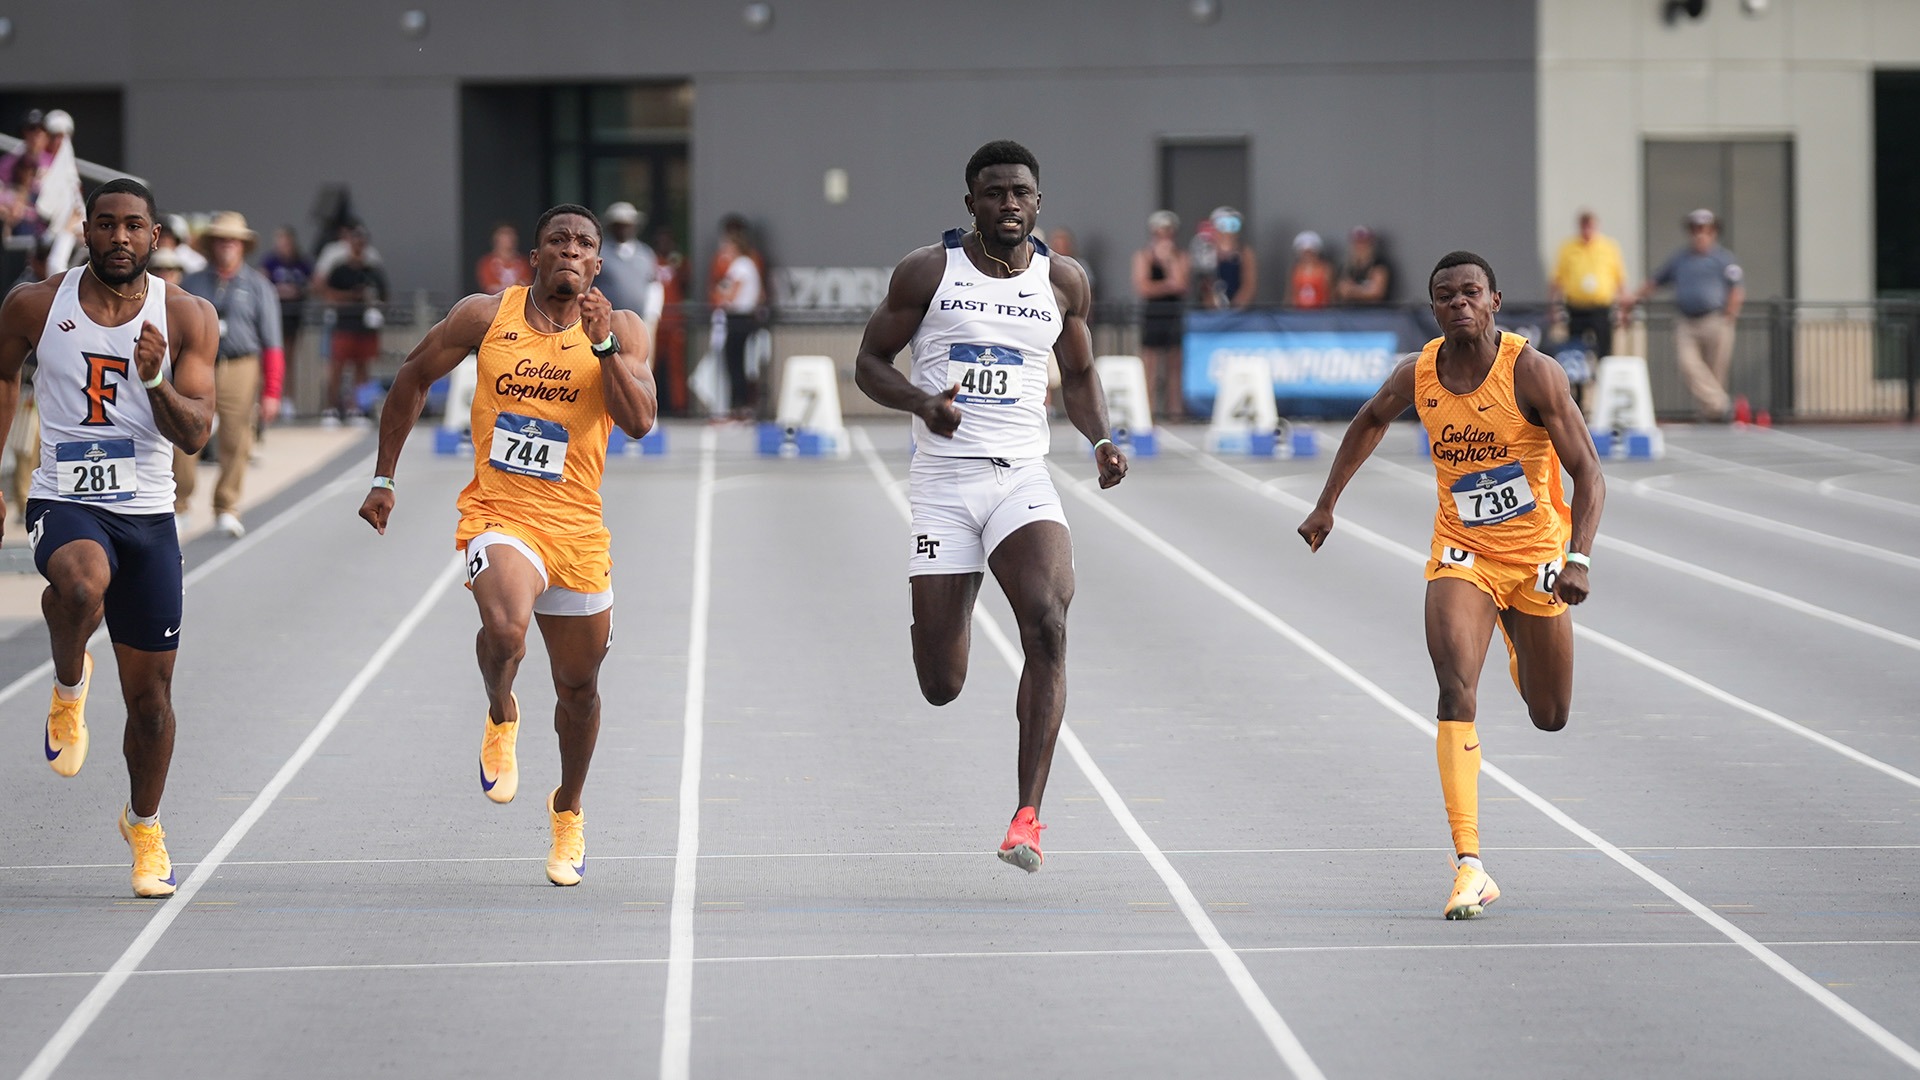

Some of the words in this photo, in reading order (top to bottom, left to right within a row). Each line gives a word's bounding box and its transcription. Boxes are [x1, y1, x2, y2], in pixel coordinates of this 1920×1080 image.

[940, 300, 988, 312] EAST
[994, 303, 1052, 322] TEXAS
[515, 358, 572, 382] Golden
[961, 368, 1008, 395] 403
[79, 351, 129, 427] F
[495, 373, 580, 403] Gophers
[800, 390, 817, 426] 7
[1232, 393, 1258, 425] 4
[1441, 424, 1495, 444] Golden
[504, 437, 550, 469] 744
[1433, 441, 1508, 467] Gophers
[73, 463, 120, 493] 281
[1469, 485, 1519, 518] 738
[916, 534, 940, 559] ET
[1543, 559, 1560, 593] 6
